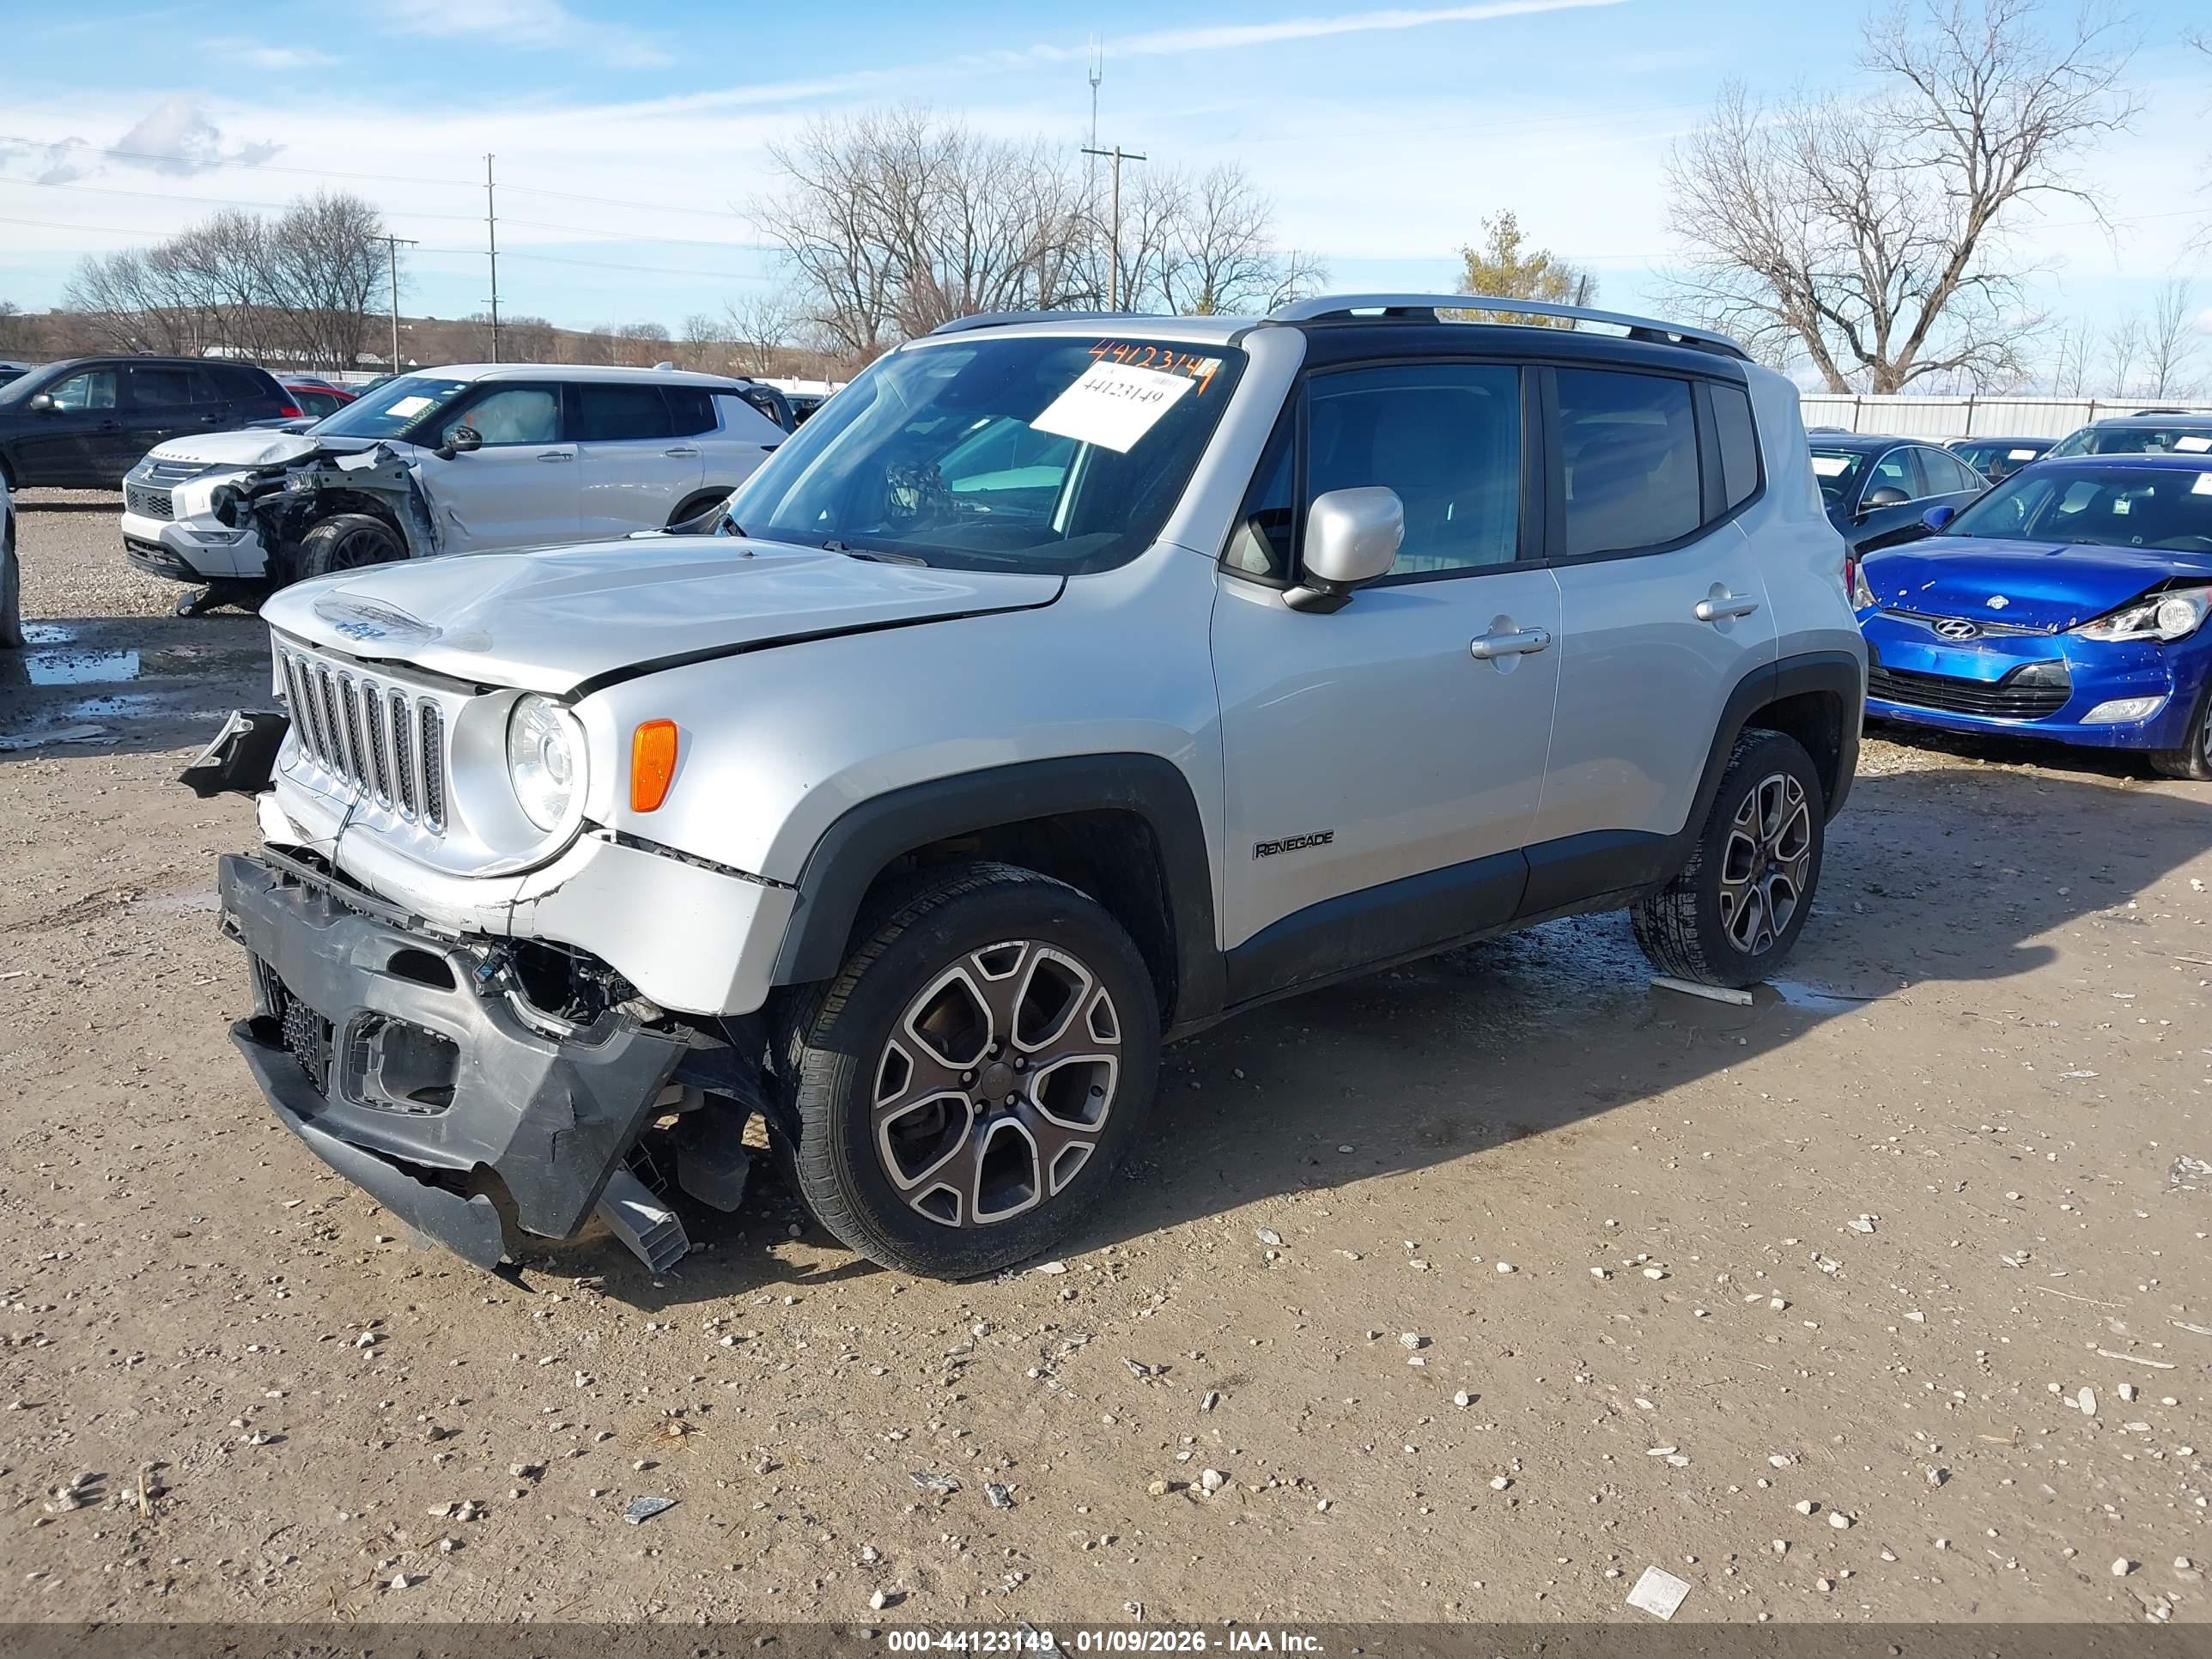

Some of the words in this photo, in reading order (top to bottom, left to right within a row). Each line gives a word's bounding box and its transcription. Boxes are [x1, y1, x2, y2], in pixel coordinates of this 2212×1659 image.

[1089, 338, 1217, 398] 44123149
[1084, 378, 1164, 404] 44123149
[1253, 829, 1334, 860] RENEGADE
